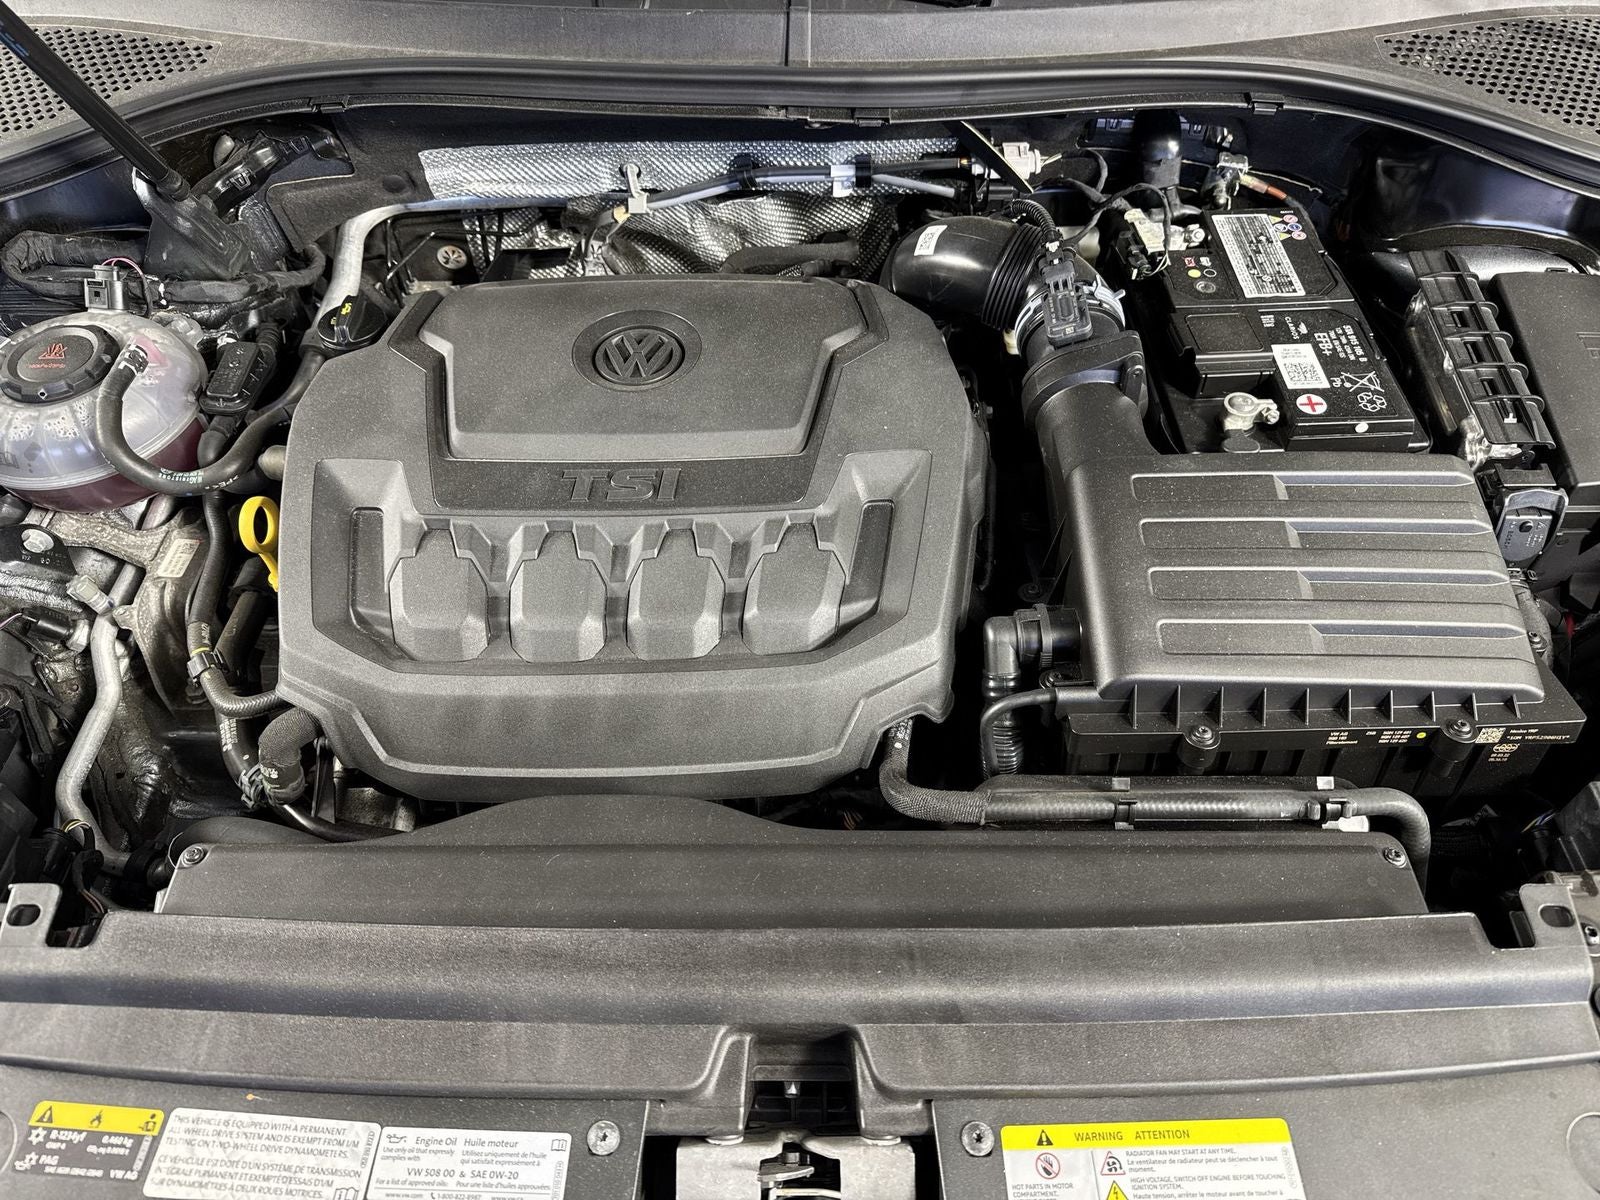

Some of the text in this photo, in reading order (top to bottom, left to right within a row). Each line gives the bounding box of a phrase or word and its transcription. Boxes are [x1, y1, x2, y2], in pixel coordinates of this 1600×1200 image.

[1285, 316, 1299, 340] CLARIOS
[1314, 332, 1333, 356] EFB+
[561, 468, 682, 501] TSI
[174, 1115, 190, 1124] THIS
[191, 1116, 221, 1126] VEHICLE
[231, 1119, 270, 1130] EQUIPPED
[299, 1125, 347, 1136] PERMANENT
[166, 1137, 197, 1146] TESTING
[197, 1139, 209, 1148] ON
[260, 1144, 284, 1153] DRIVE
[211, 1128, 235, 1138] DRIVE
[235, 1131, 264, 1140] SYSTEM
[265, 1134, 282, 1142] AND
[292, 1135, 321, 1145] EXEMPT
[322, 1137, 345, 1147] FROM
[416, 1137, 457, 1147] Engine Oil
[464, 1138, 486, 1147] Huile
[1074, 1130, 1190, 1142] WARNING ATTENTION
[158, 1155, 167, 1163] CE
[169, 1155, 204, 1166] VÉHICULE
[206, 1157, 219, 1166] EST
[220, 1158, 240, 1169] DOTÉ
[294, 1165, 305, 1174] DE
[306, 1166, 362, 1178] TRANSMISSION
[194, 1168, 238, 1180] PERMANENT
[407, 1168, 423, 1176] VW
[424, 1168, 441, 1177] 508
[443, 1169, 455, 1177] 00
[470, 1170, 488, 1179] SAE
[489, 1171, 519, 1180] 0W-20
[150, 1177, 164, 1185] SUR
[235, 1184, 257, 1194] DEUX
[258, 1185, 283, 1196] ROUES
[285, 1188, 323, 1199] MOTRICES.
